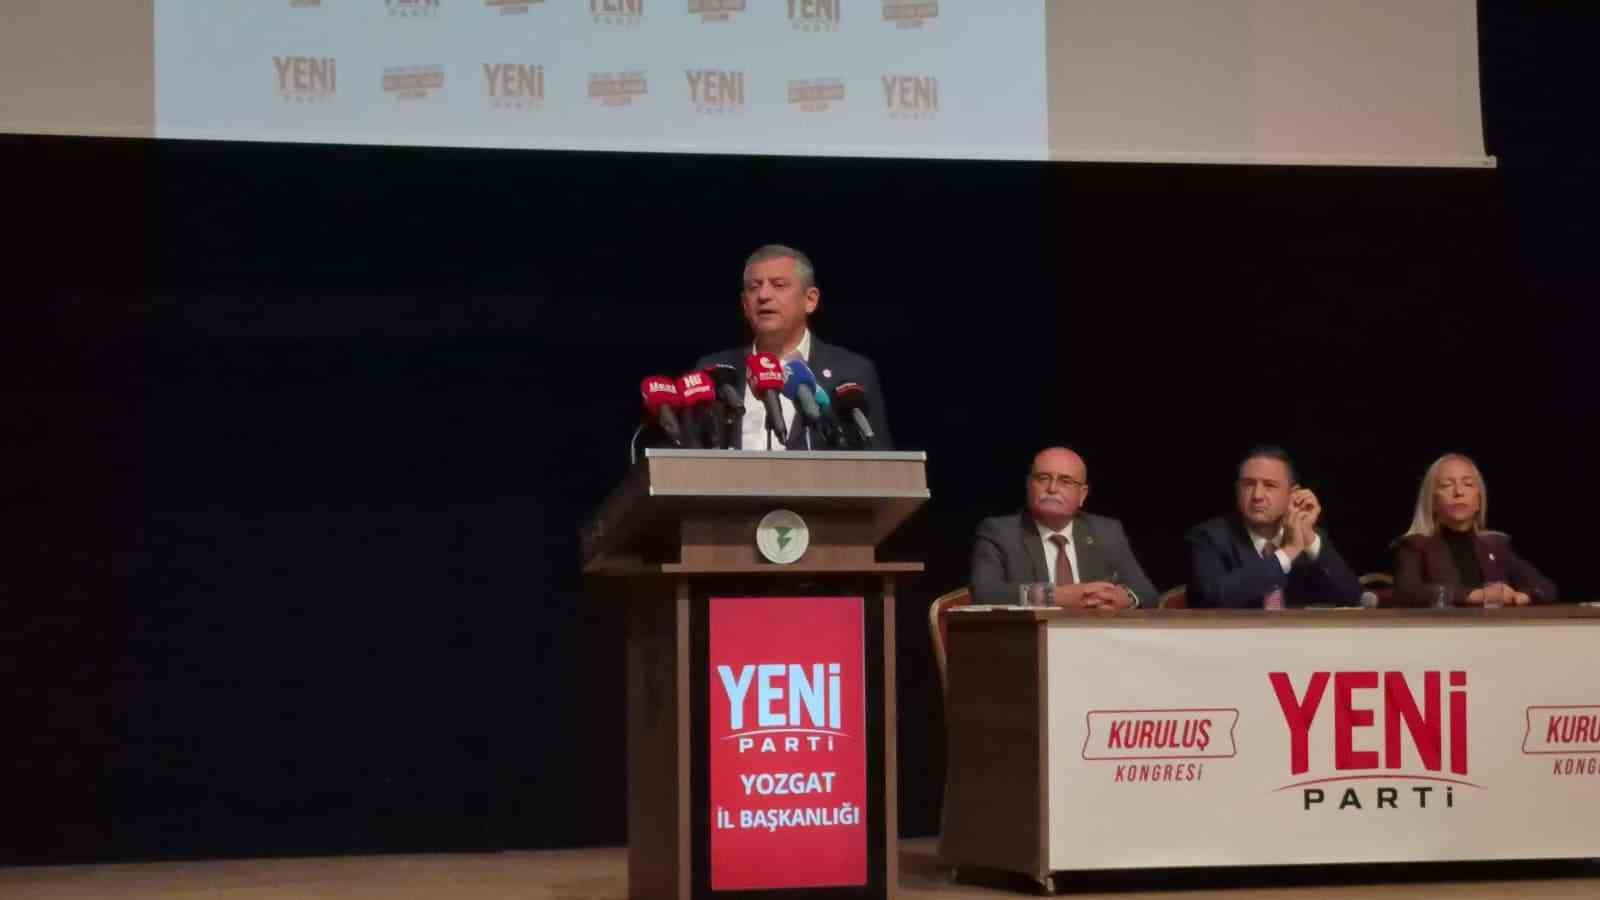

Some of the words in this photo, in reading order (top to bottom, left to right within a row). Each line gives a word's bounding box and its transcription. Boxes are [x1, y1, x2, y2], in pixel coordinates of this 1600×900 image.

[1108, 719, 1212, 751] KURULUŞ
[1552, 757, 1600, 776] KONG
[740, 771, 836, 796] YOZGAT
[717, 806, 735, 829] İL
[740, 801, 860, 832] BAŞKANLIĞI
